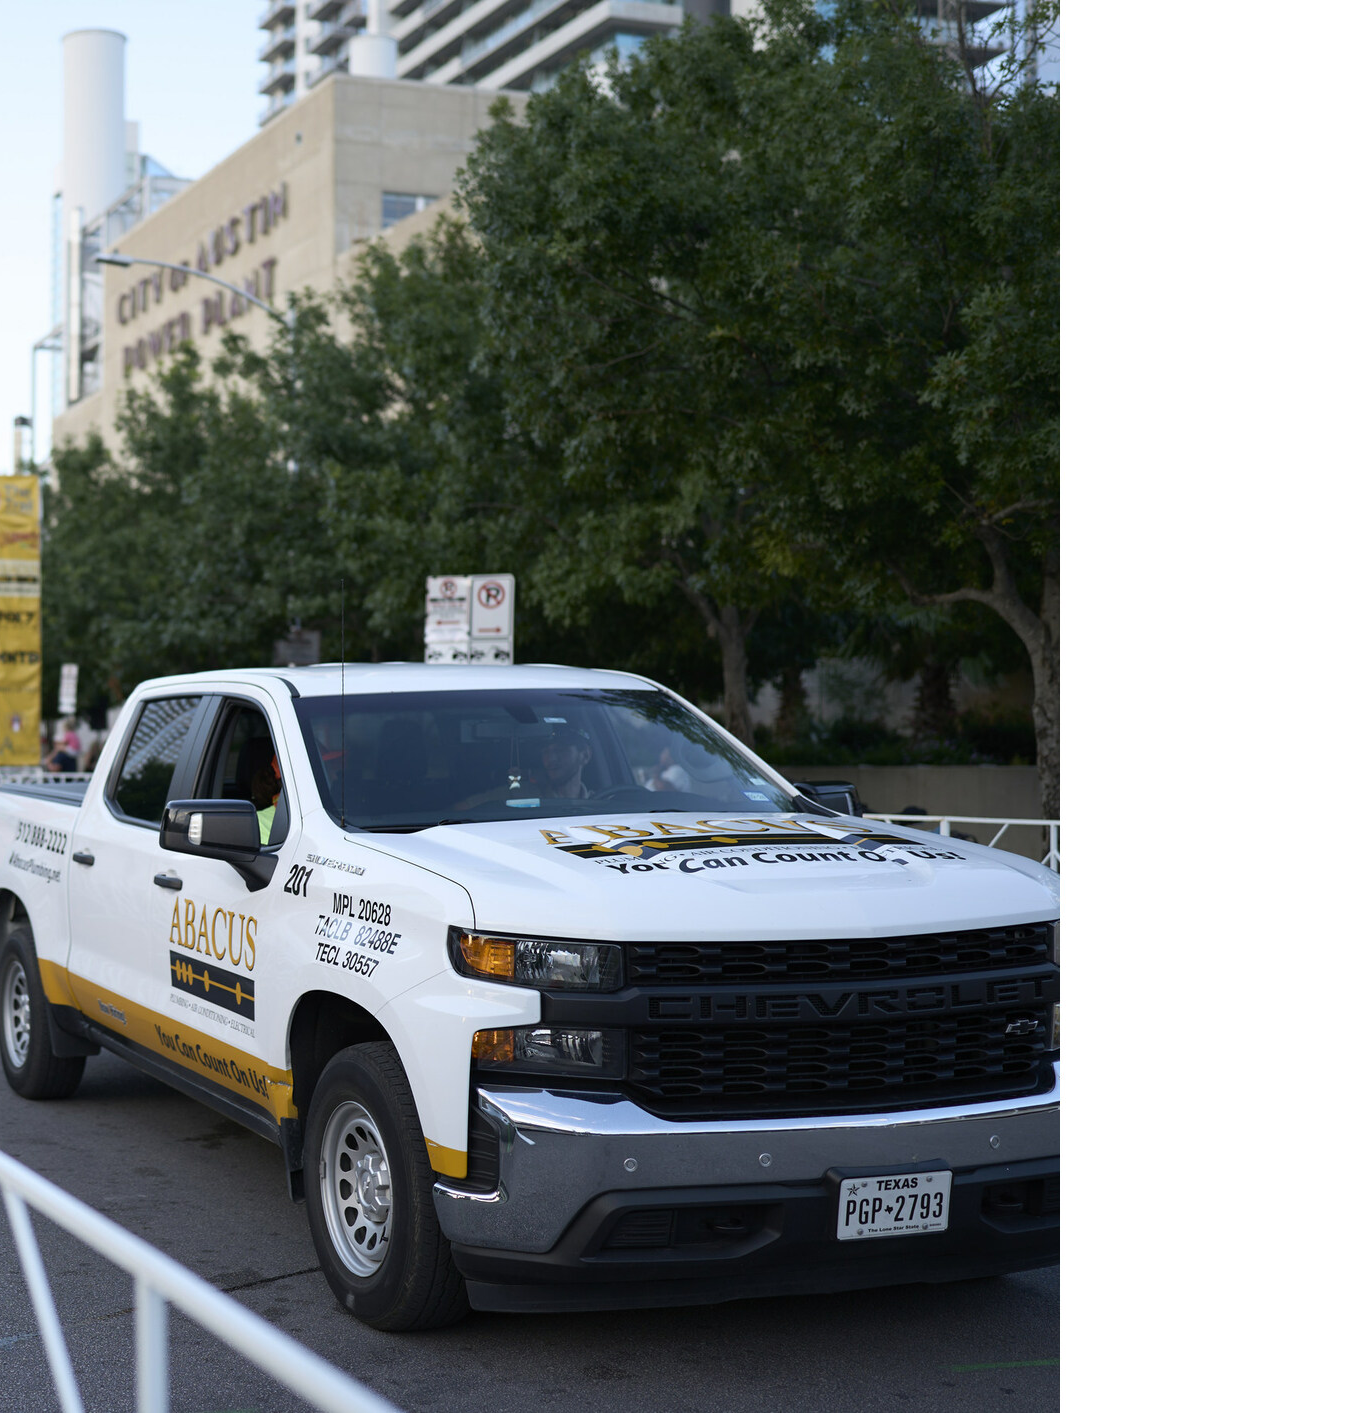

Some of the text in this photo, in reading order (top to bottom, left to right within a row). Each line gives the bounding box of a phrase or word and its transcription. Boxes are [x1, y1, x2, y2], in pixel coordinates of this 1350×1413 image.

[117, 269, 165, 326] CITY
[197, 181, 290, 275] AUSTIN
[15, 821, 31, 844] 512
[678, 856, 750, 874] Can
[751, 850, 858, 865] Count
[905, 850, 967, 861] Us!
[283, 864, 314, 898] 201
[332, 892, 392, 927] MPL 20628
[169, 896, 258, 972] ABACUS
[314, 914, 402, 955] TACLB 82488E
[315, 942, 380, 978] TECL 30557
[649, 974, 1054, 1022] CHEVROLET
[154, 1023, 270, 1100] You Can Count On Us!
[876, 1177, 919, 1192] TEXAS
